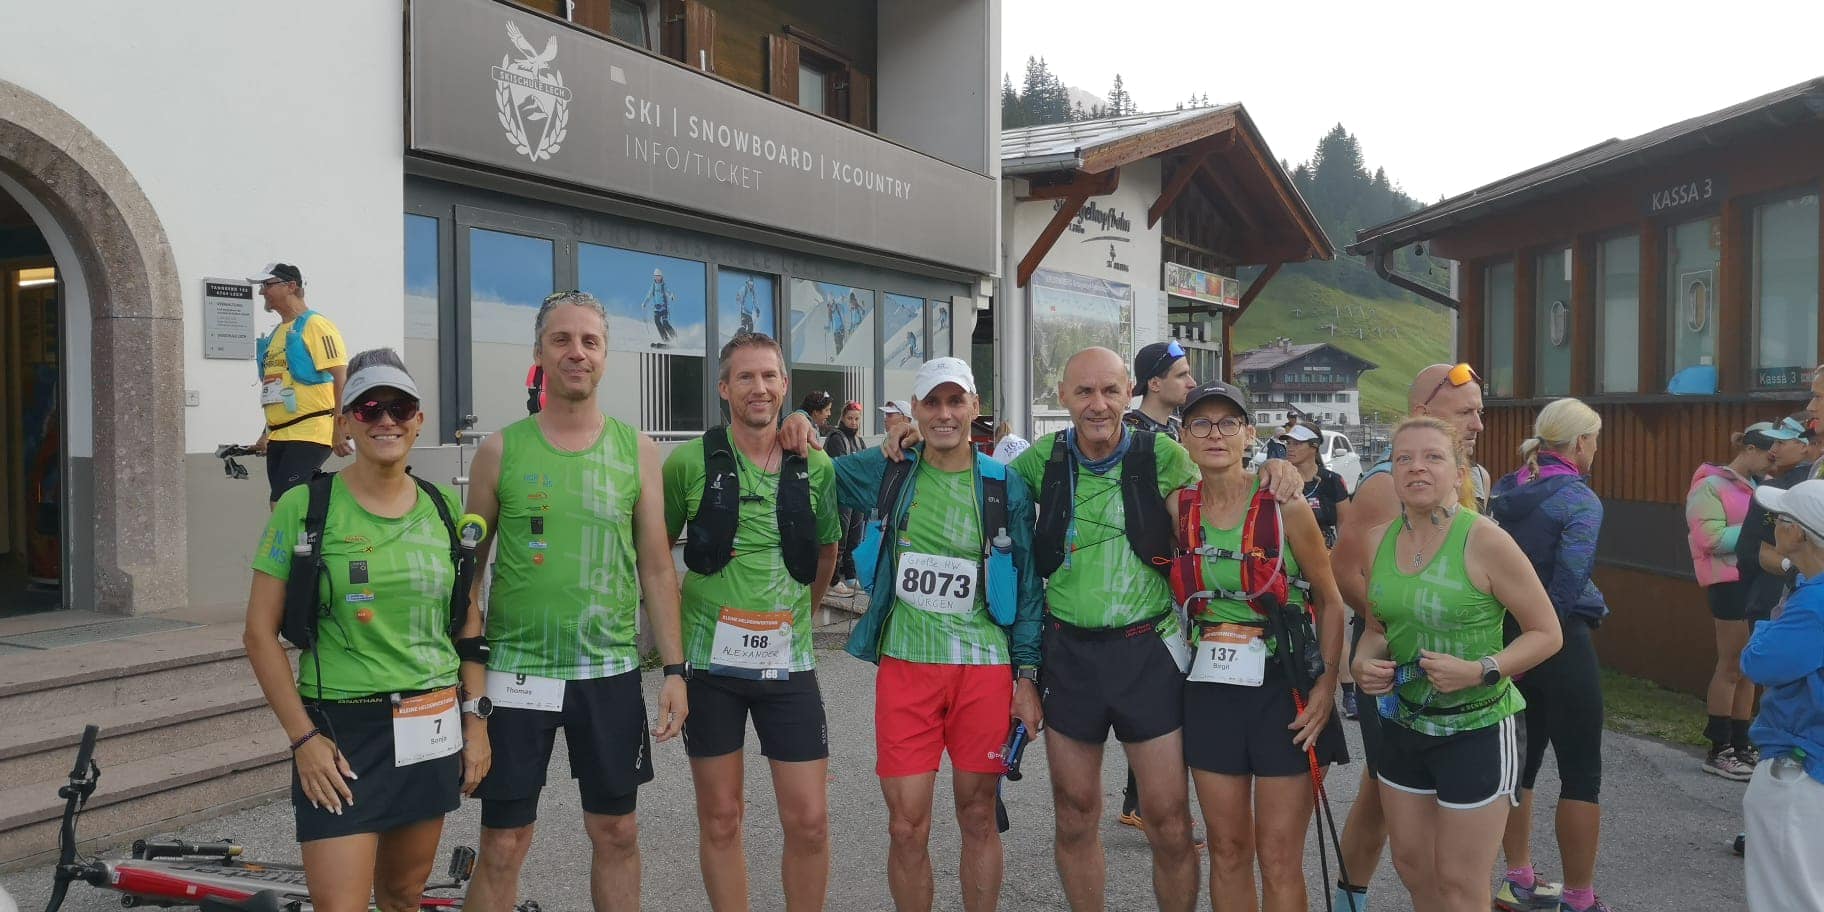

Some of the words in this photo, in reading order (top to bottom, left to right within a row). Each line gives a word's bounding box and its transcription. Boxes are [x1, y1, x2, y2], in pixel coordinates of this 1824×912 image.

[501, 71, 544, 91] SKISCHULE
[625, 95, 660, 127] SKI
[689, 115, 812, 171] SNOWBOARD
[832, 160, 911, 200] XCOUNTRY
[625, 134, 763, 191] INFO/TICKET
[1652, 182, 1699, 211] KASSA
[1703, 178, 1713, 199] 3
[1760, 372, 1787, 385] Kassa
[1790, 371, 1798, 384] 3
[902, 567, 971, 599] 8073
[741, 633, 769, 649] 168
[722, 645, 779, 658] ALEXANDER
[1210, 647, 1237, 662] 137
[761, 669, 778, 679] 168
[1213, 662, 1230, 671] Birgit
[506, 686, 532, 695] Thomas
[433, 718, 442, 735] 7
[430, 736, 448, 745] Sonja
